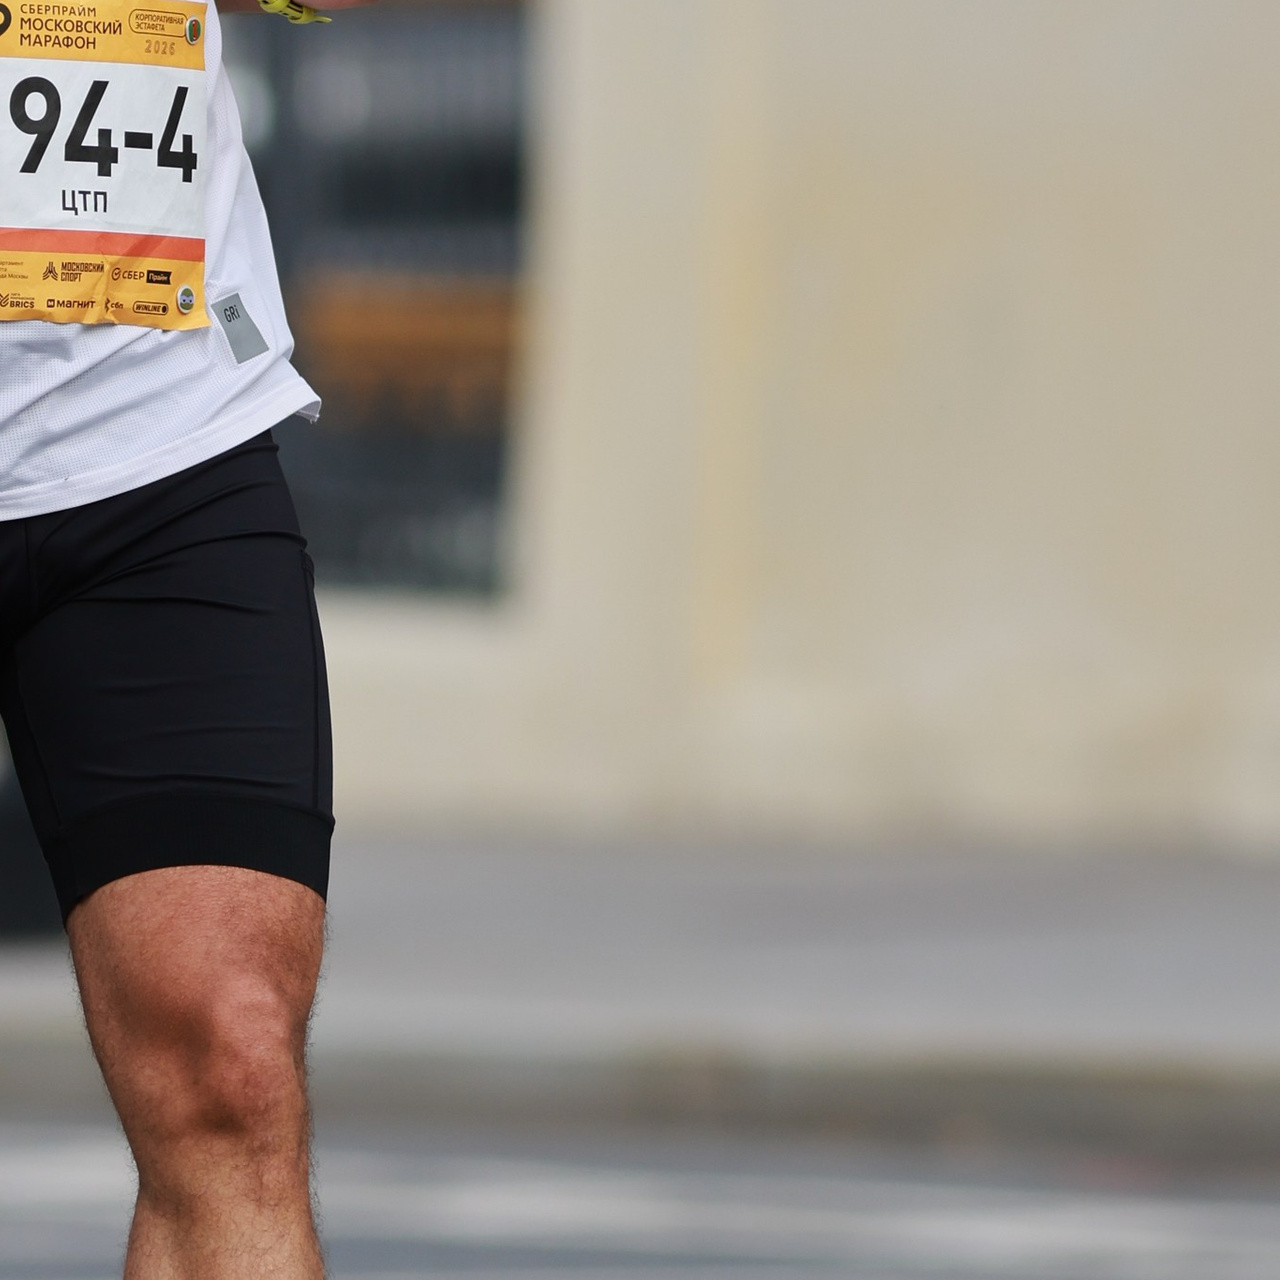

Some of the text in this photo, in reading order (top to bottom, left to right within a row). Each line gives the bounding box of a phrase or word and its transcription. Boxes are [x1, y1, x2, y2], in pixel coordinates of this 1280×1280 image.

[20, 4, 96, 17] СБЕРПРАЙМ
[135, 13, 184, 26] КОРПОРАТИВНАЯ
[19, 17, 122, 36] МОСКОВСКИЙ
[135, 21, 165, 32] ЭСТАФЕТА
[19, 33, 96, 50] МАРАФОН
[61, 189, 109, 216] ЦТП
[61, 262, 105, 273] МОСКОВСКИЙ
[61, 273, 82, 282] СПОРТ
[122, 271, 145, 280] СБЕР
[10, 301, 35, 309] BRICS
[135, 303, 162, 313] WINLINE
[223, 304, 241, 323] GRi
